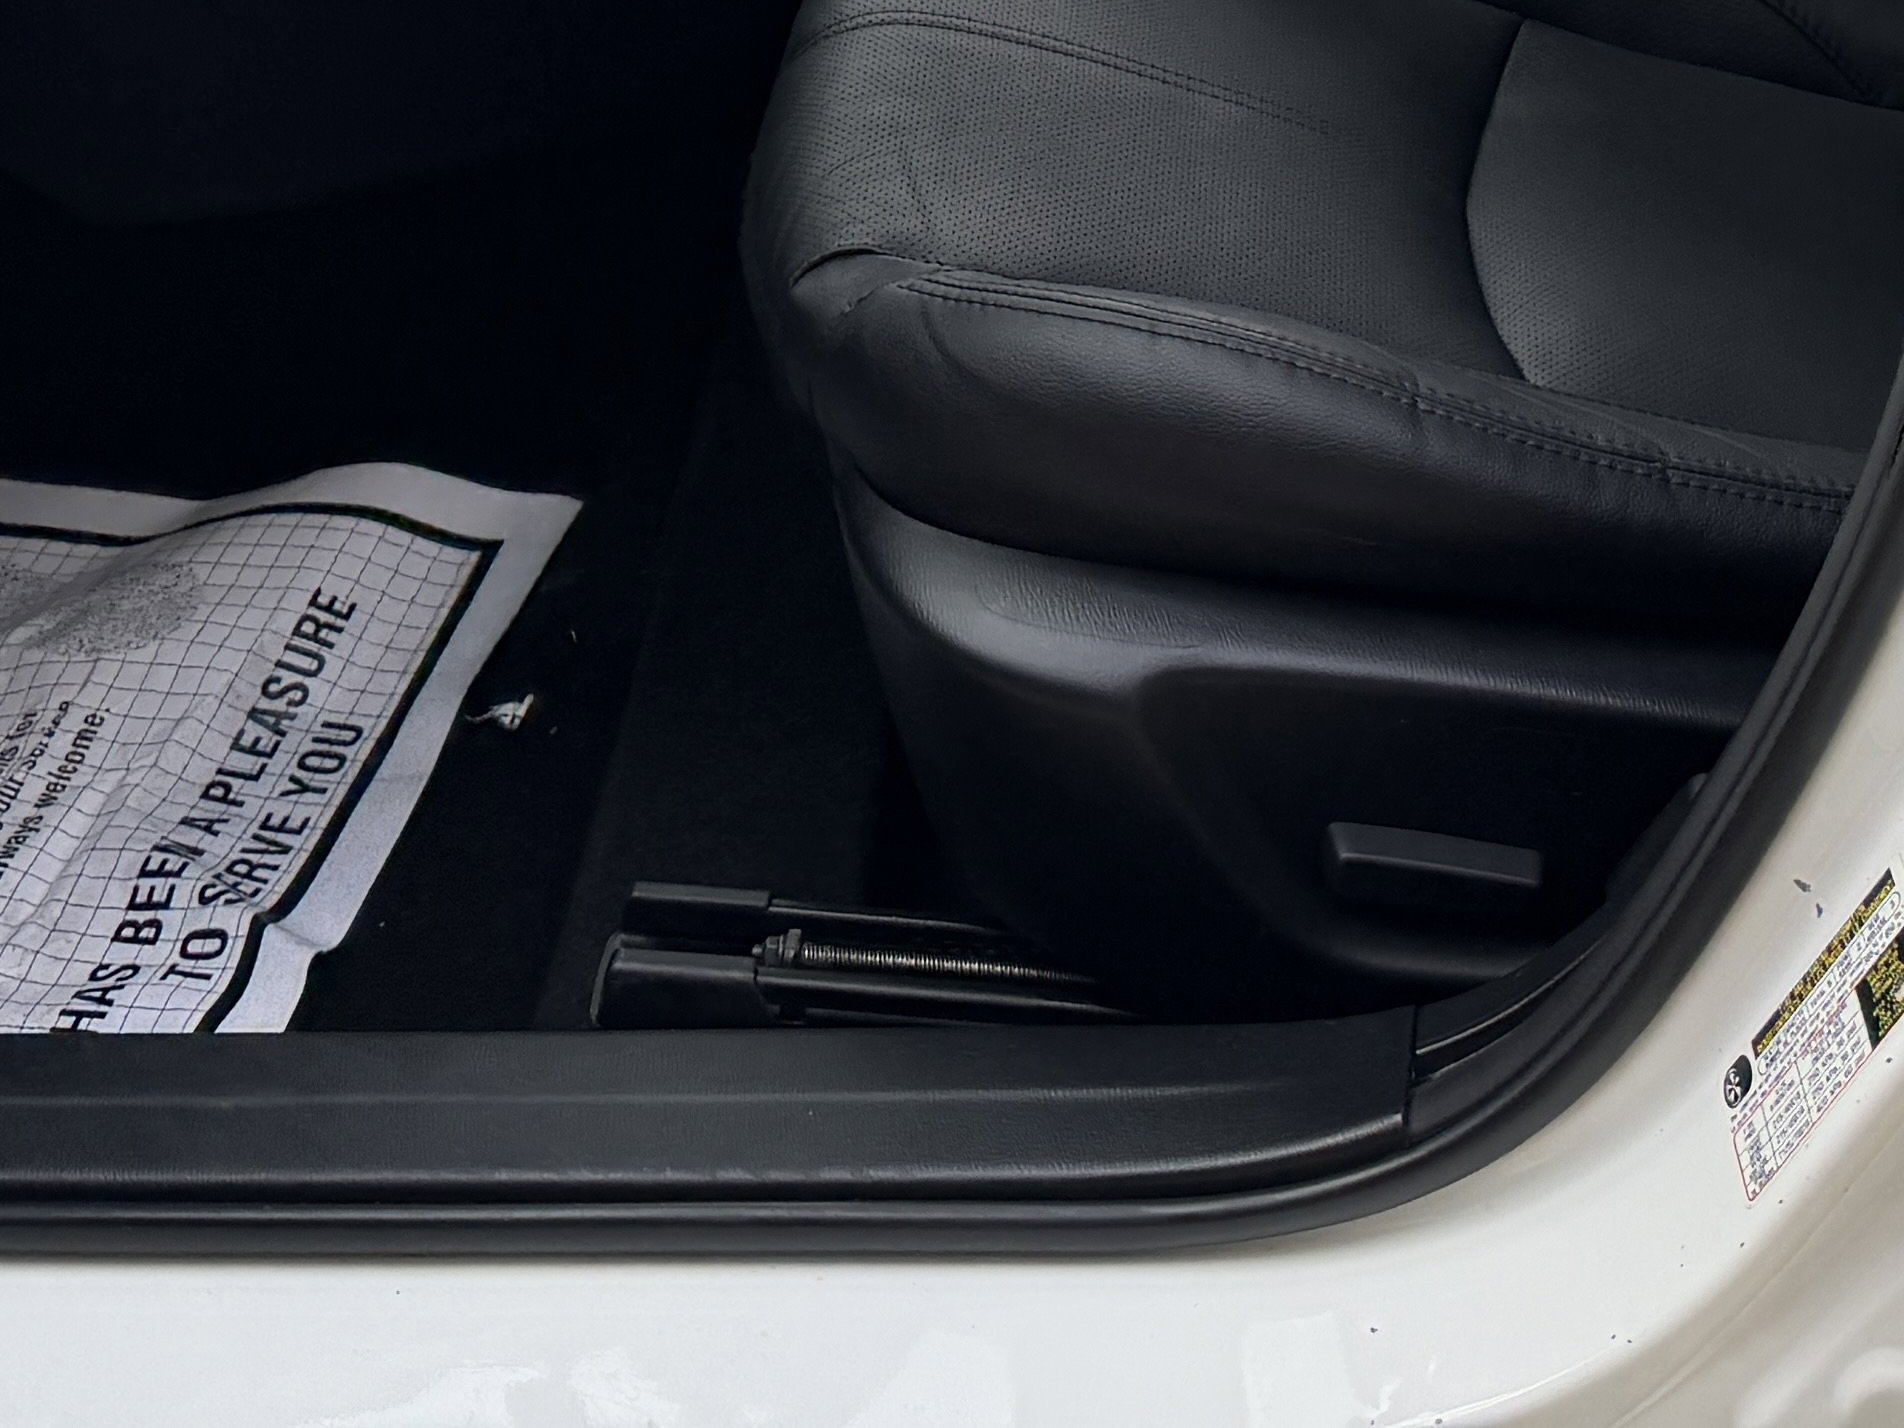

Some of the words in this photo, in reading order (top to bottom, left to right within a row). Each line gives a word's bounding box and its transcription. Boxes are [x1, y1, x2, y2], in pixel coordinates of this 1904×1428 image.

[200, 587, 359, 808] PLEASURE
[160, 926, 229, 983] TO
[197, 811, 313, 907] SERVE
[282, 720, 365, 797] YOU
[180, 814, 231, 837] A
[111, 836, 207, 946] BEEN
[50, 962, 141, 1033] HAS
